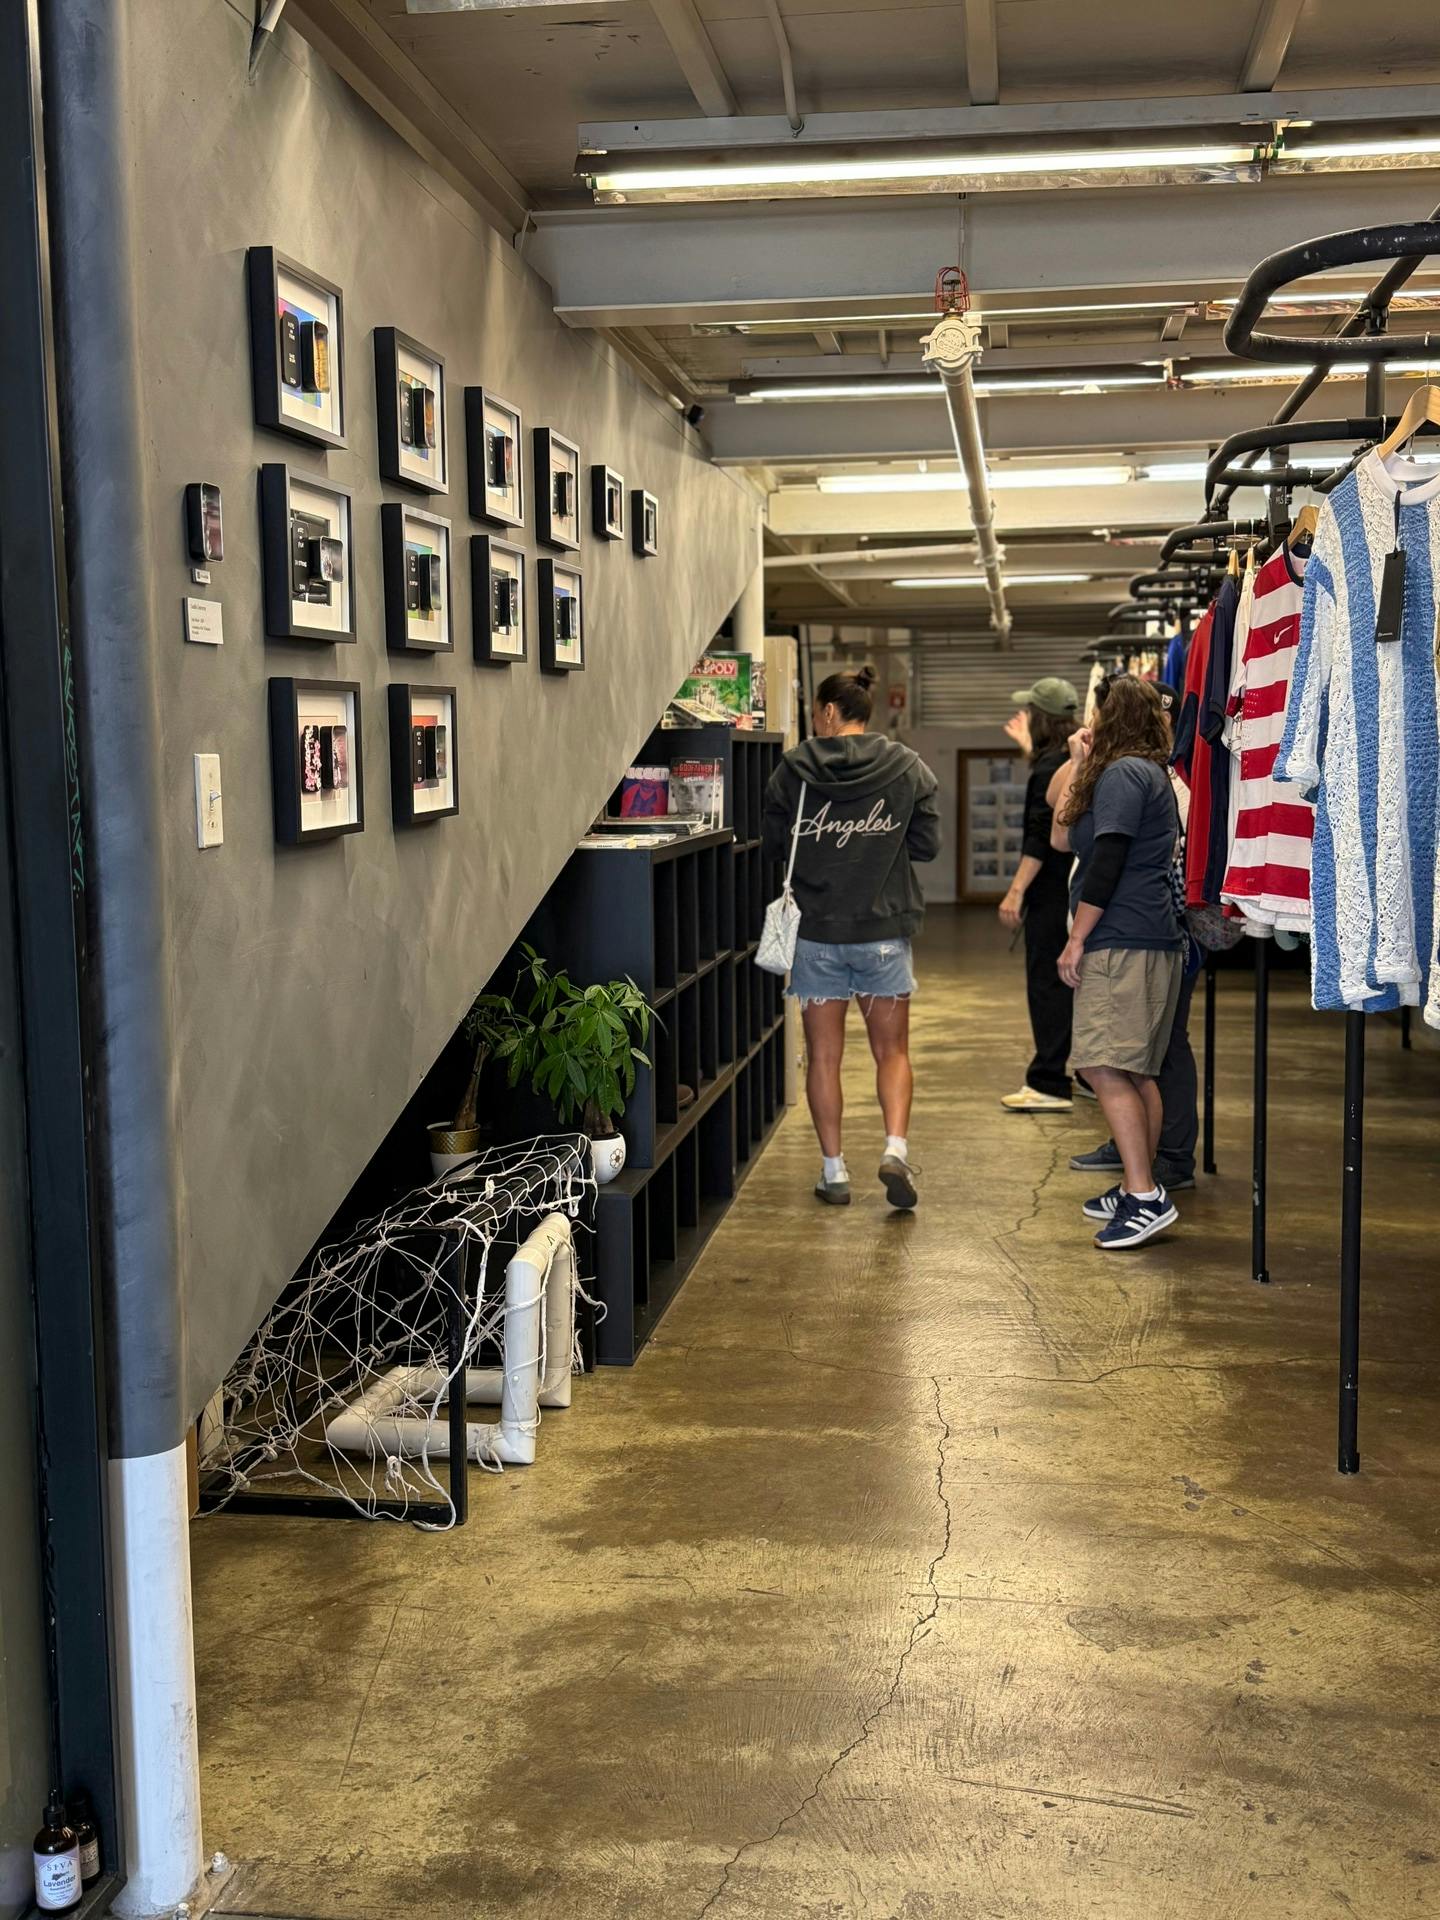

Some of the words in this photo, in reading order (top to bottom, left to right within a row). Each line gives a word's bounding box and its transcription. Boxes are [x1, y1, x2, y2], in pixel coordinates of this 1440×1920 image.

[692, 661, 737, 675] NOPOLY
[791, 798, 901, 848] Angeles
[43, 1875, 76, 1887] Lavender
